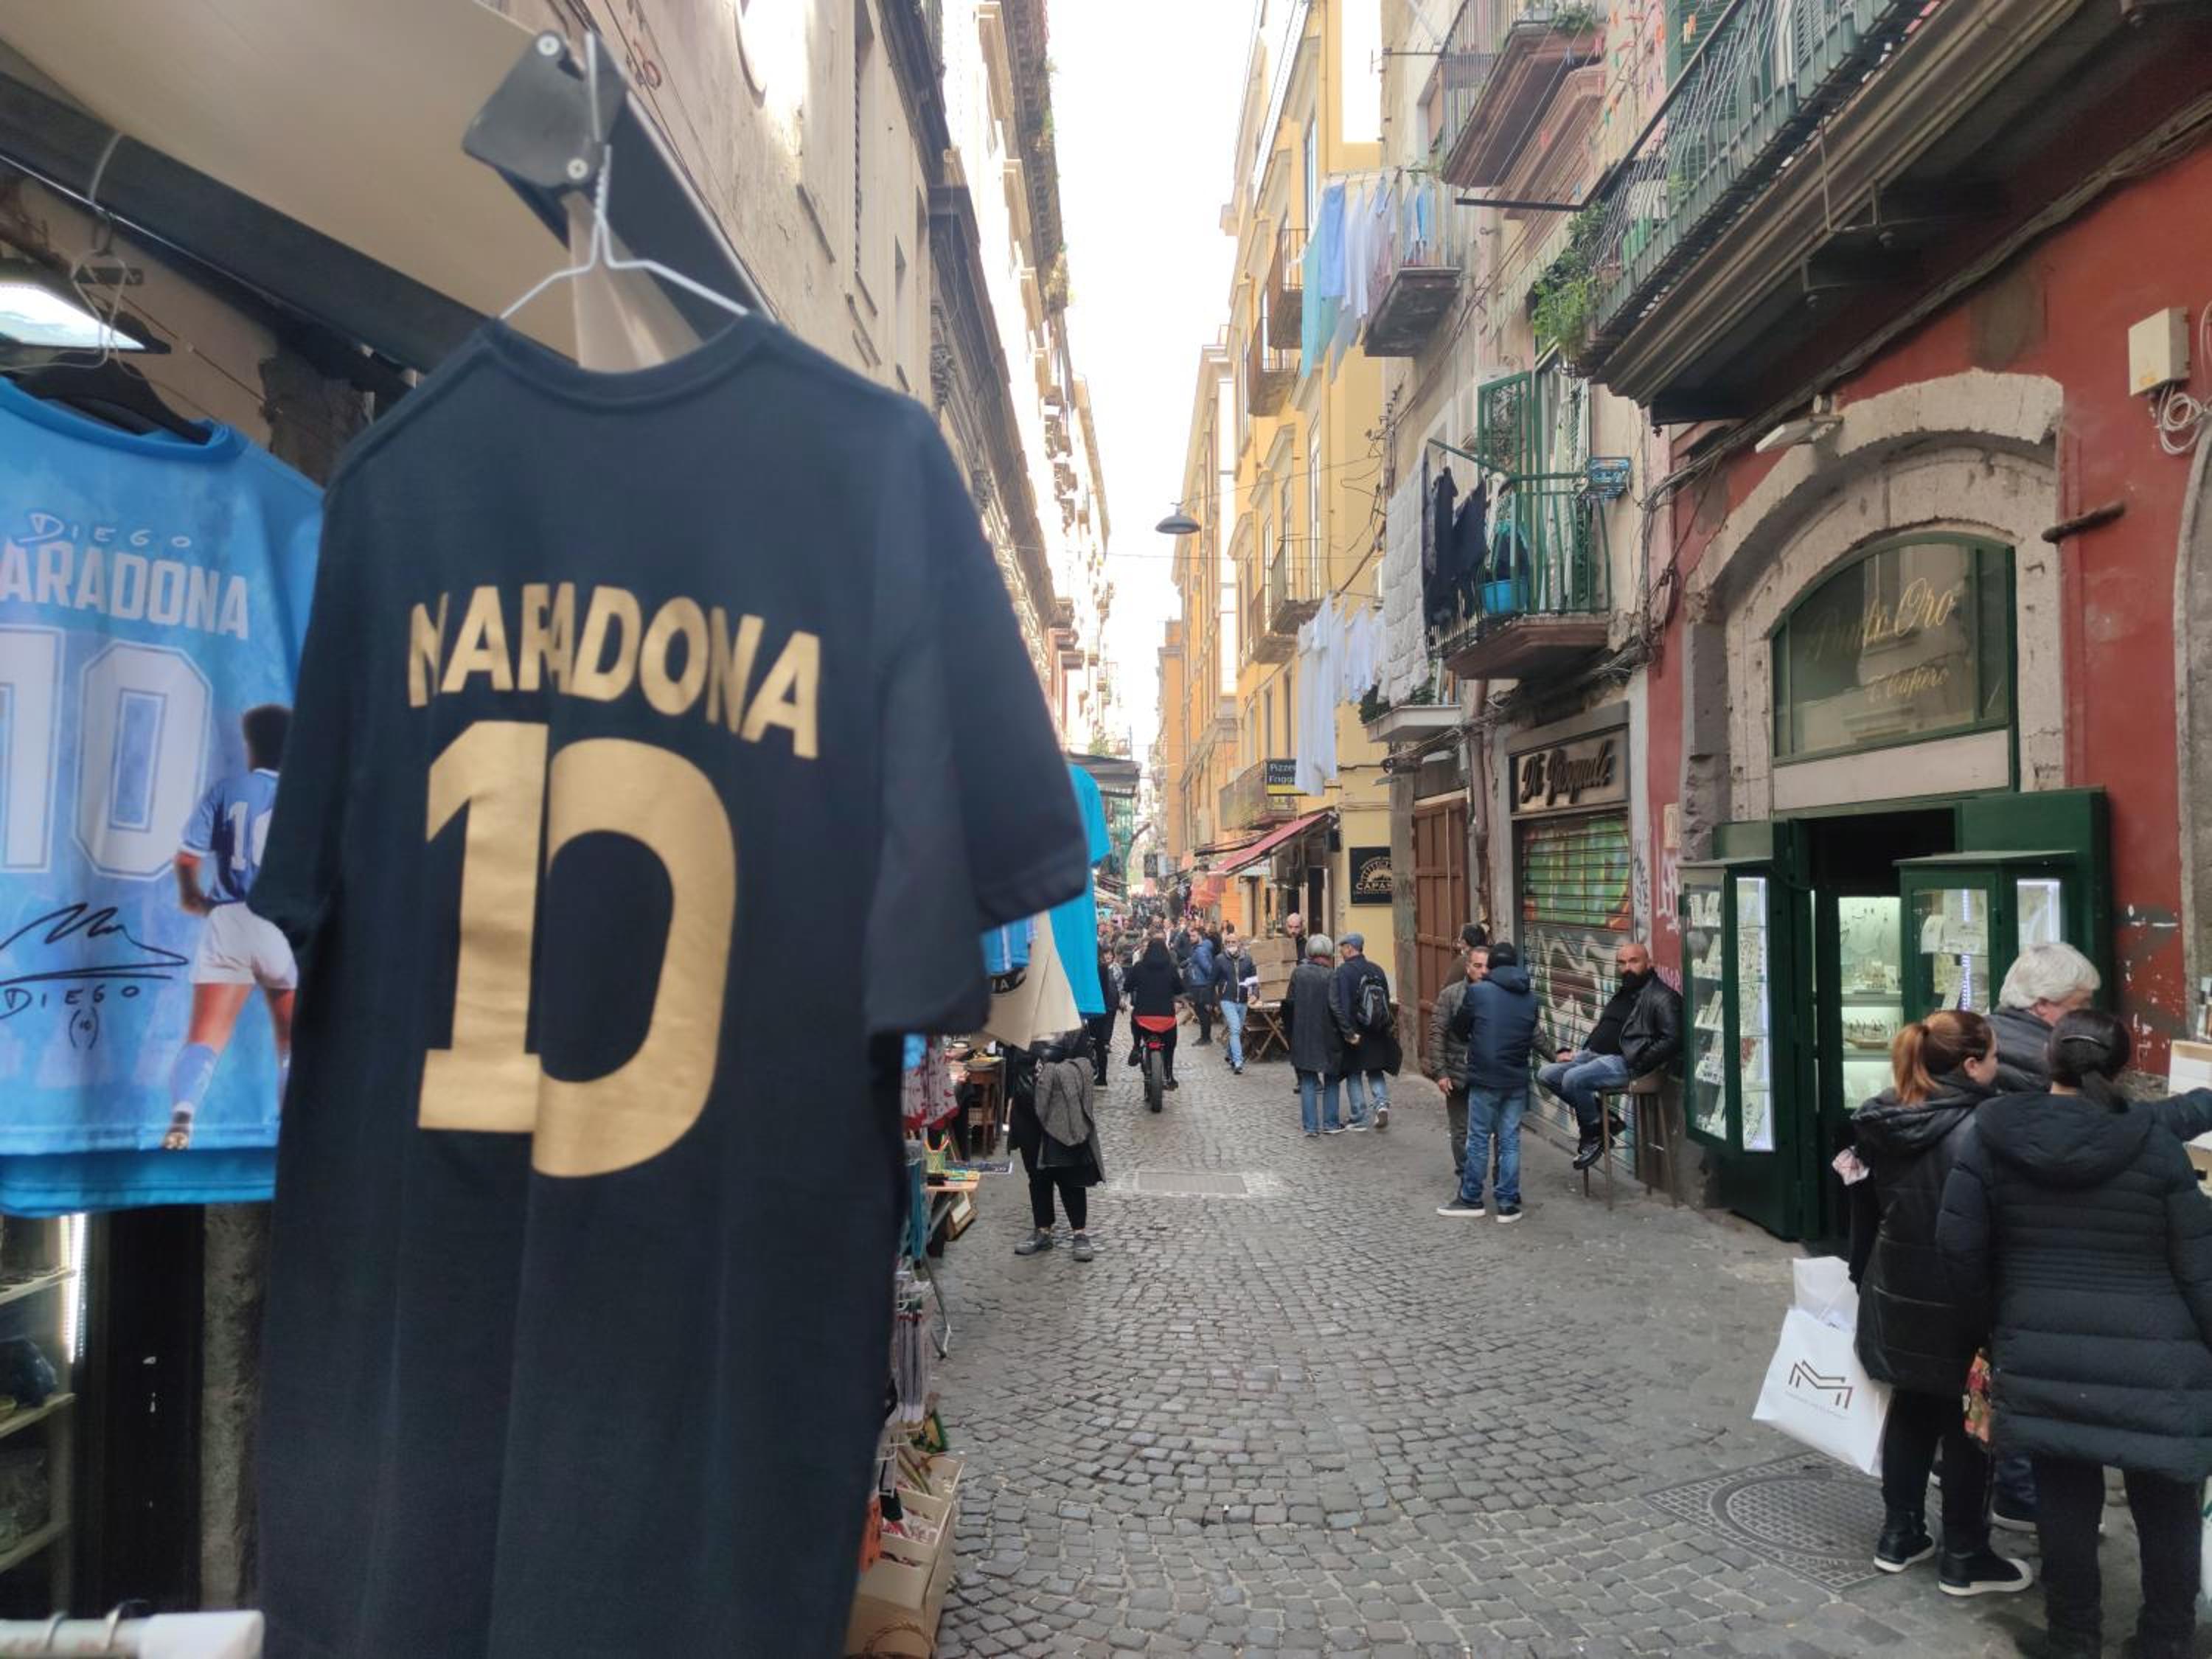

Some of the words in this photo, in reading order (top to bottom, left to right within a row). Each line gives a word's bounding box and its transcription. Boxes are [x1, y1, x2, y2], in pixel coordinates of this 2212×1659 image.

[18, 512, 192, 547] DIEGO
[0, 538, 249, 640] ARADONA
[417, 720, 737, 1178] 10
[0, 984, 141, 1019] DIEGO
